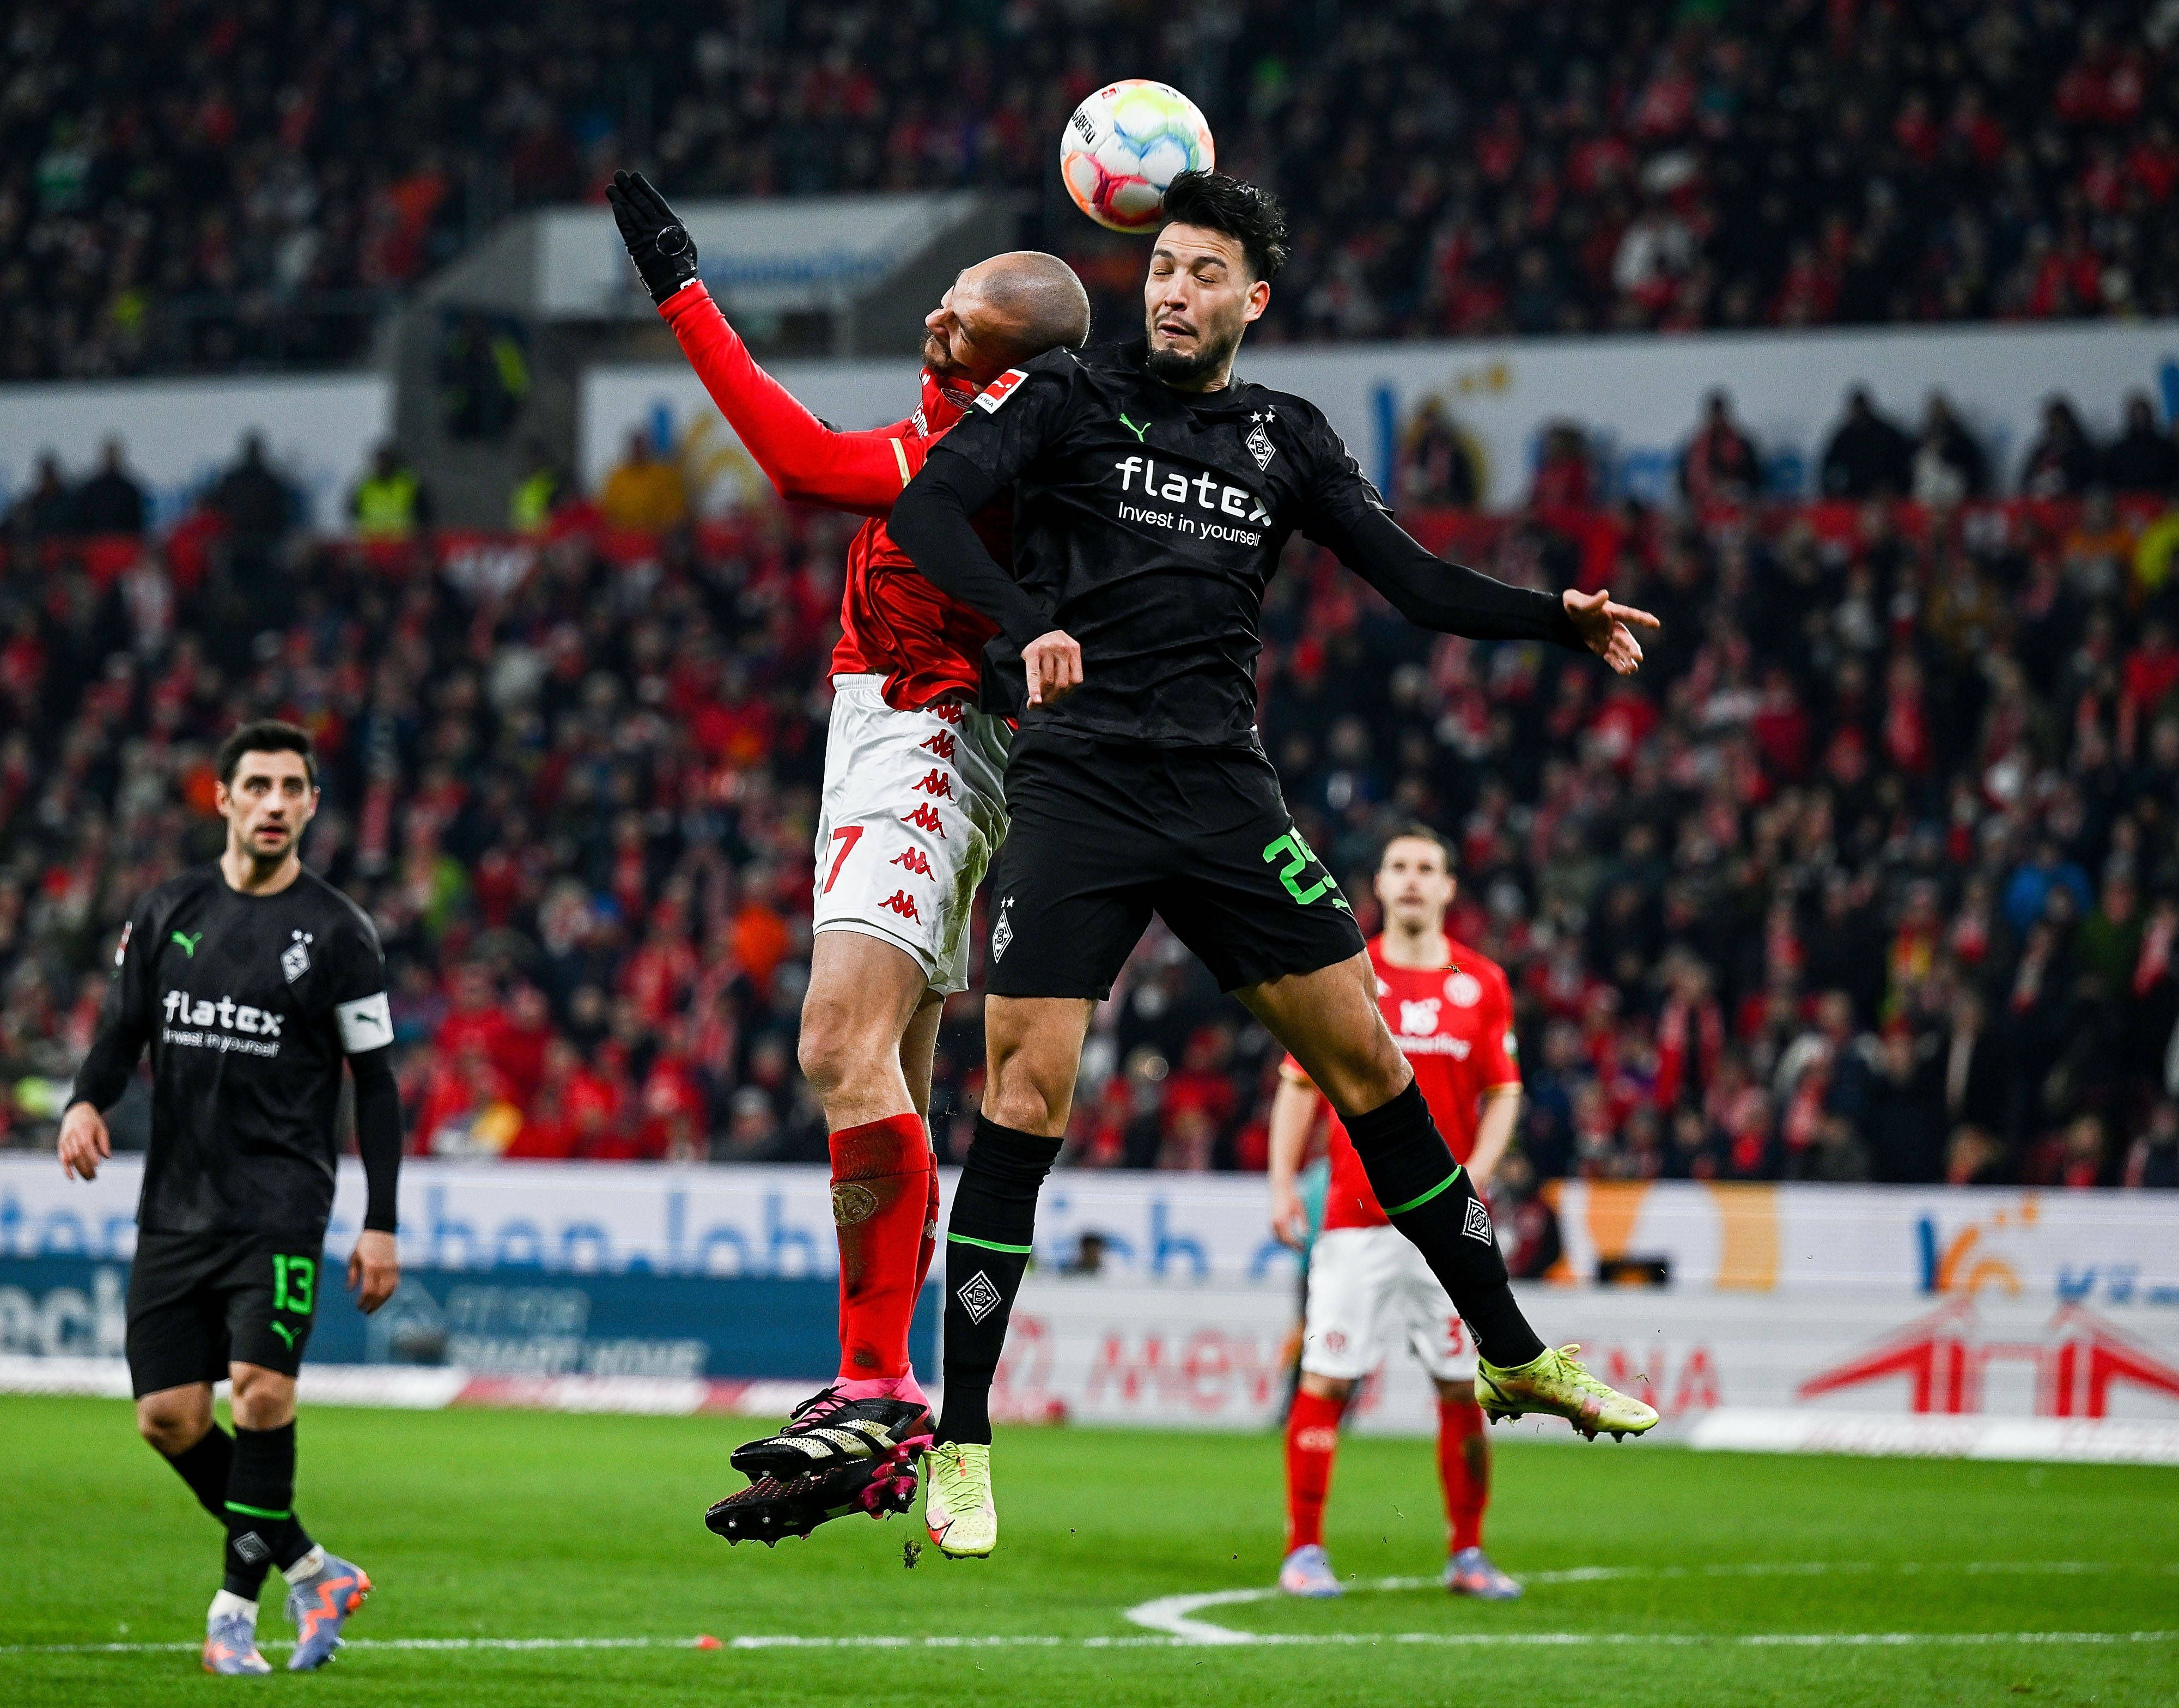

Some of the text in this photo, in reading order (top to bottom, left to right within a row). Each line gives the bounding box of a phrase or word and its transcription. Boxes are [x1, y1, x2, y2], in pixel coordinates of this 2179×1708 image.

[1115, 456, 1271, 526] flatex
[1118, 501, 1173, 528] Invest
[1178, 514, 1194, 533] in
[162, 990, 285, 1037] flatex
[272, 1253, 316, 1315] 13
